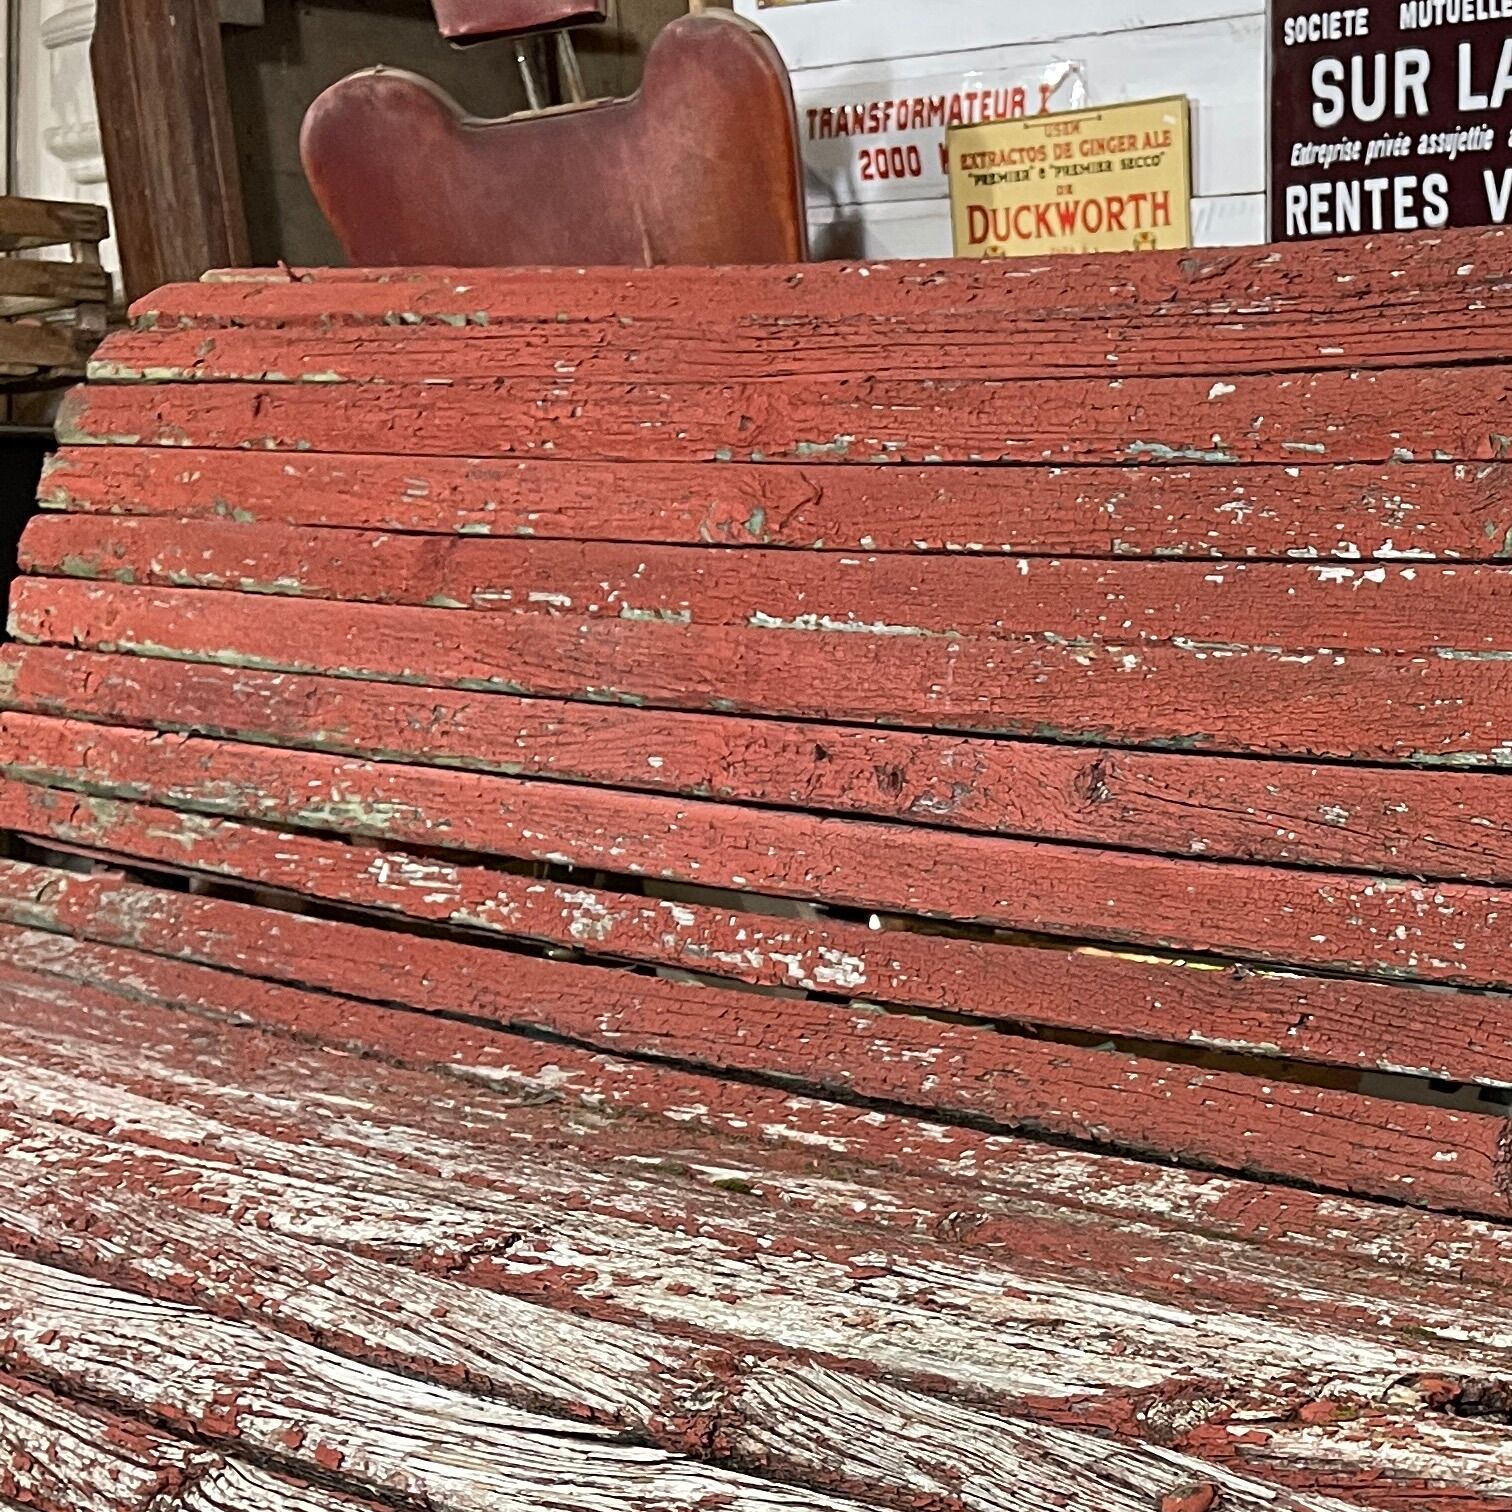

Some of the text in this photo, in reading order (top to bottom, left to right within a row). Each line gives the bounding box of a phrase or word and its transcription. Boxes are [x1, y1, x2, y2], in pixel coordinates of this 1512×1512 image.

[1284, 8, 1369, 46] SOCIETE
[1311, 48, 1430, 128] SUR
[806, 86, 1025, 141] TRANSFORMATEUR
[859, 145, 922, 181] 2000
[960, 146, 1047, 171] EXTRACTOS
[1053, 141, 1073, 160] DE
[1079, 134, 1137, 158] GINGER
[1142, 130, 1172, 149] ALE
[1290, 136, 1362, 169] Entreprise
[1417, 123, 1495, 161] assujettie
[966, 190, 1172, 245] DUCKWORTH
[1286, 173, 1449, 236] RENTES
